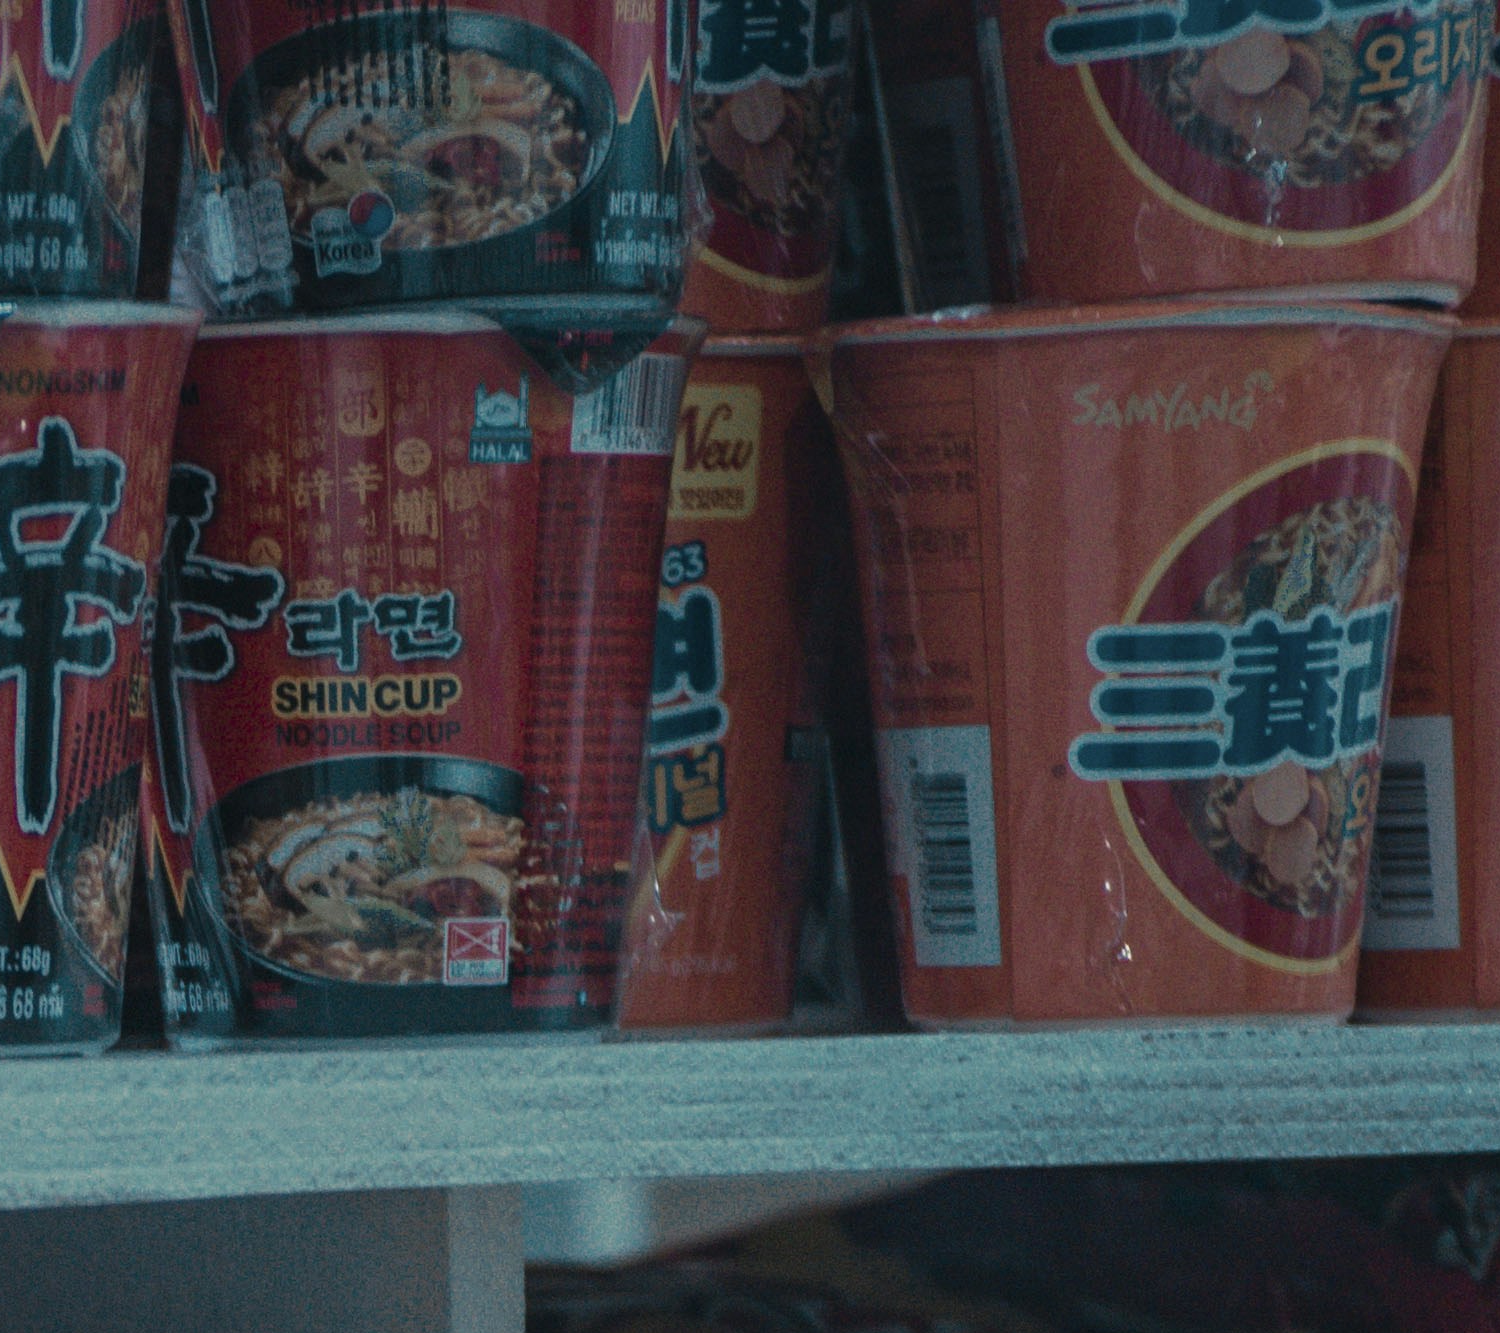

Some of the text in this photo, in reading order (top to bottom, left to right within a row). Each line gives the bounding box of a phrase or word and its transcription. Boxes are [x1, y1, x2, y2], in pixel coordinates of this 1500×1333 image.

[1355, 15, 1480, 104] 오리지
[318, 239, 378, 264] Korea
[470, 443, 529, 462] HALAL
[677, 402, 754, 475] New
[284, 588, 463, 672] 라면
[273, 677, 460, 715] SHIN CUP
[274, 719, 462, 748] NOODLE SOUP
[12, 988, 34, 1020] 68
